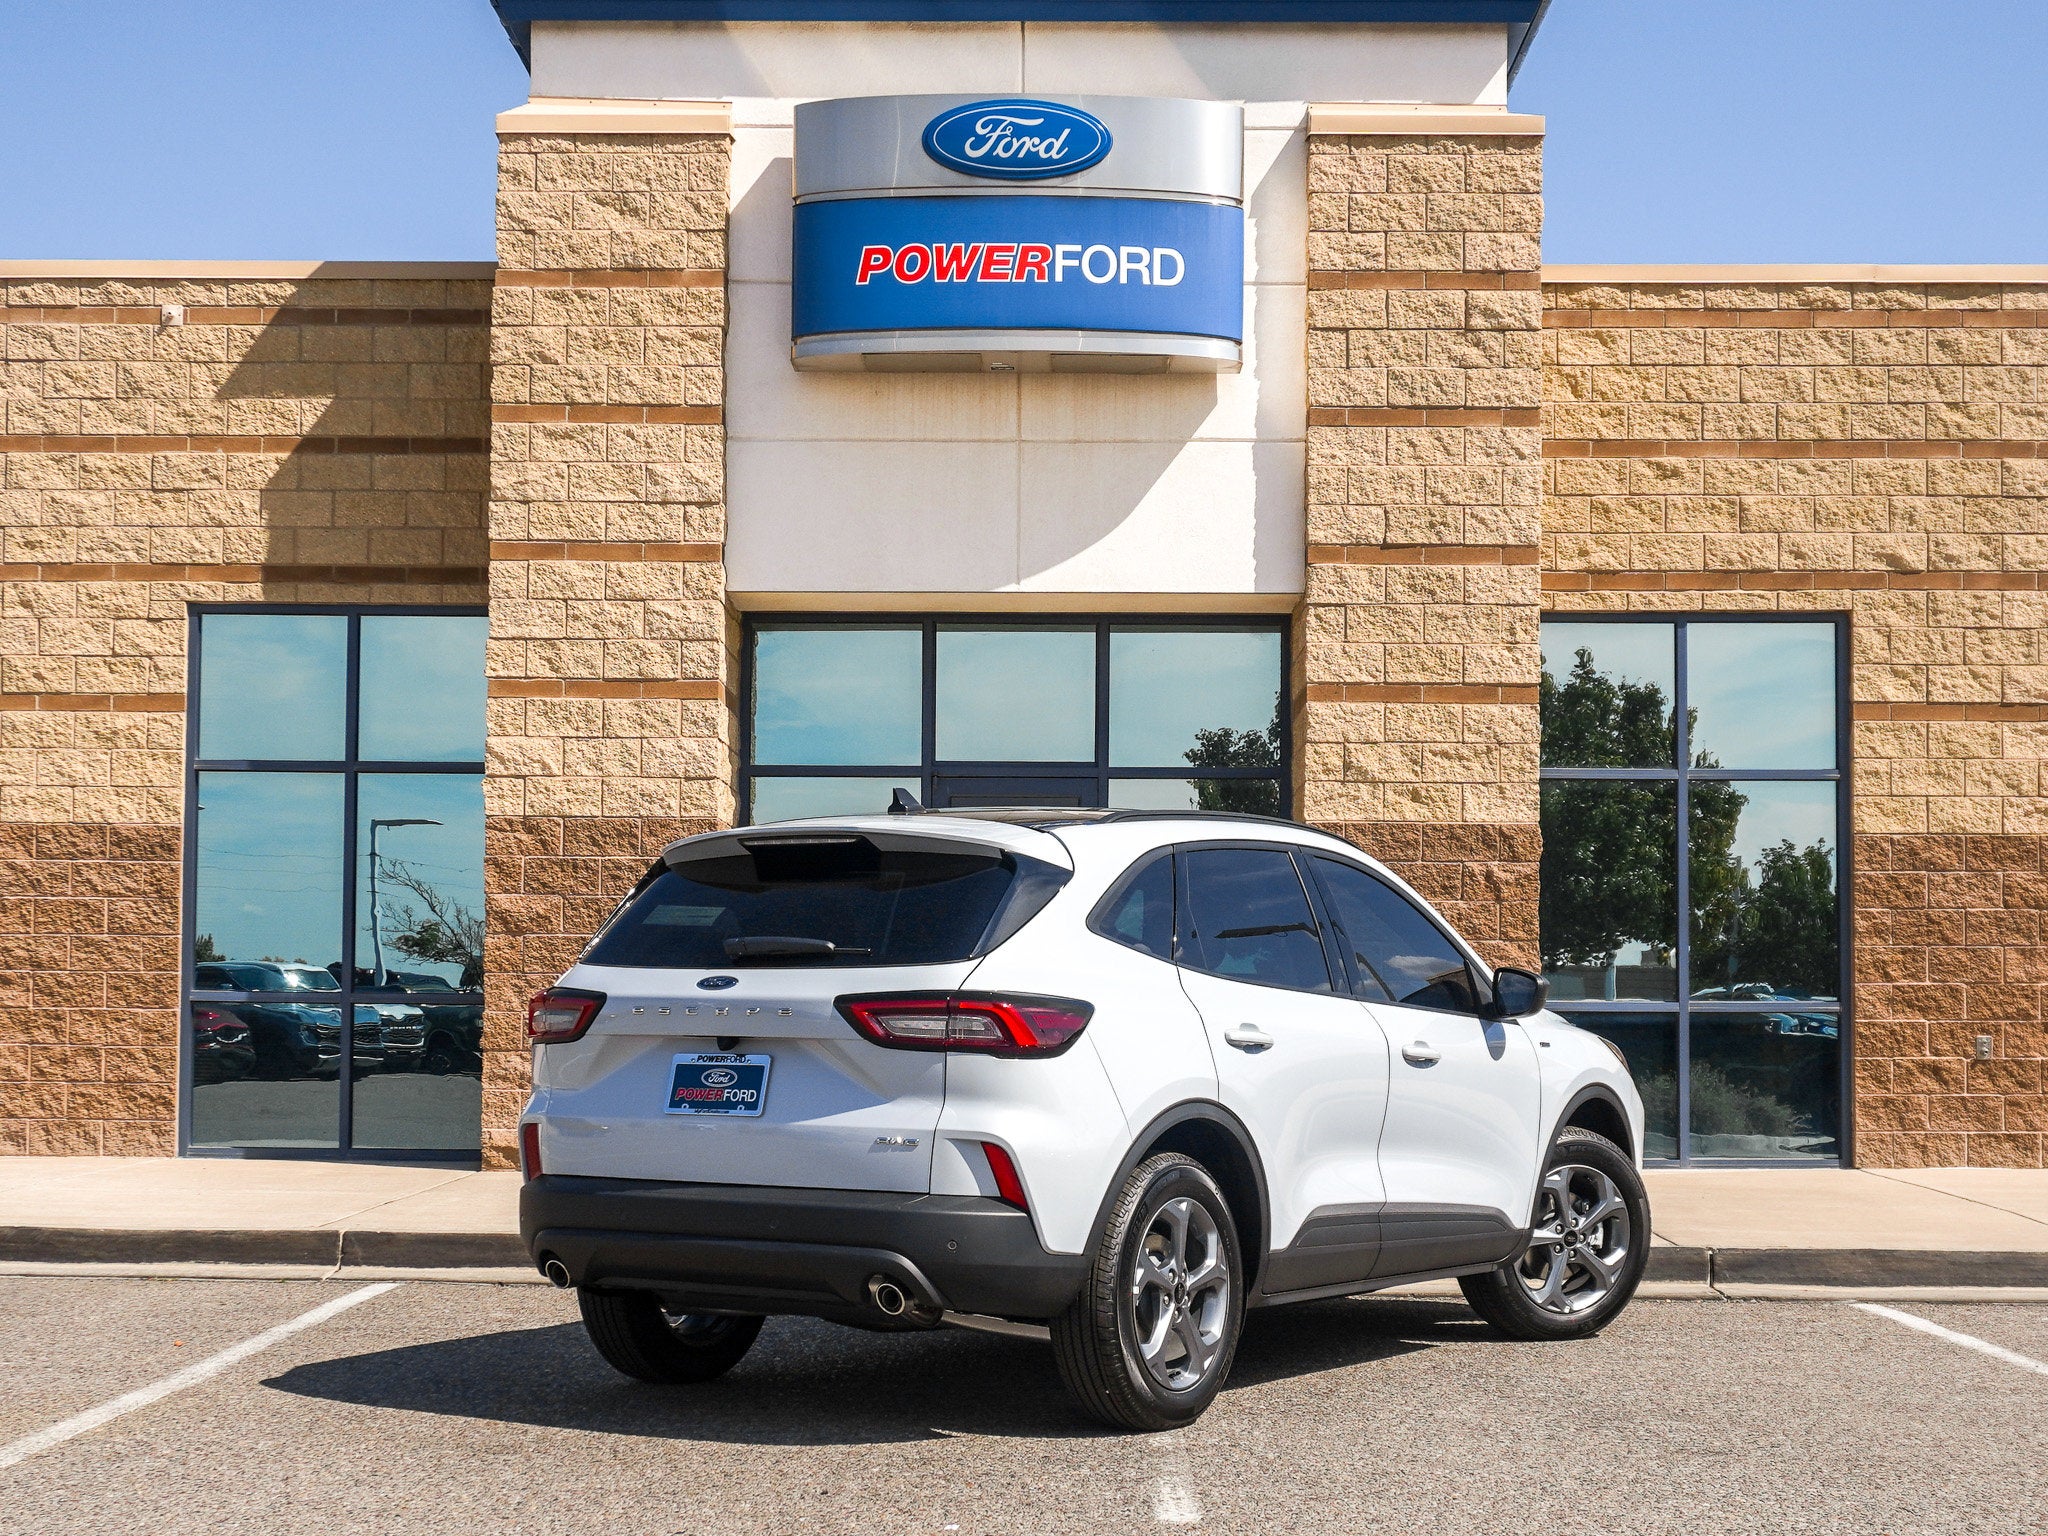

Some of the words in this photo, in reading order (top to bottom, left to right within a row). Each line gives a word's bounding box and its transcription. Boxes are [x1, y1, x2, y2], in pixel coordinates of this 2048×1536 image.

[964, 115, 1071, 160] Ford
[856, 242, 1186, 287] POWERFORD
[632, 1006, 793, 1016] ESCAPE
[697, 1055, 747, 1064] POWERFORD
[708, 1071, 731, 1083] Ford
[675, 1088, 757, 1102] POWERFORD
